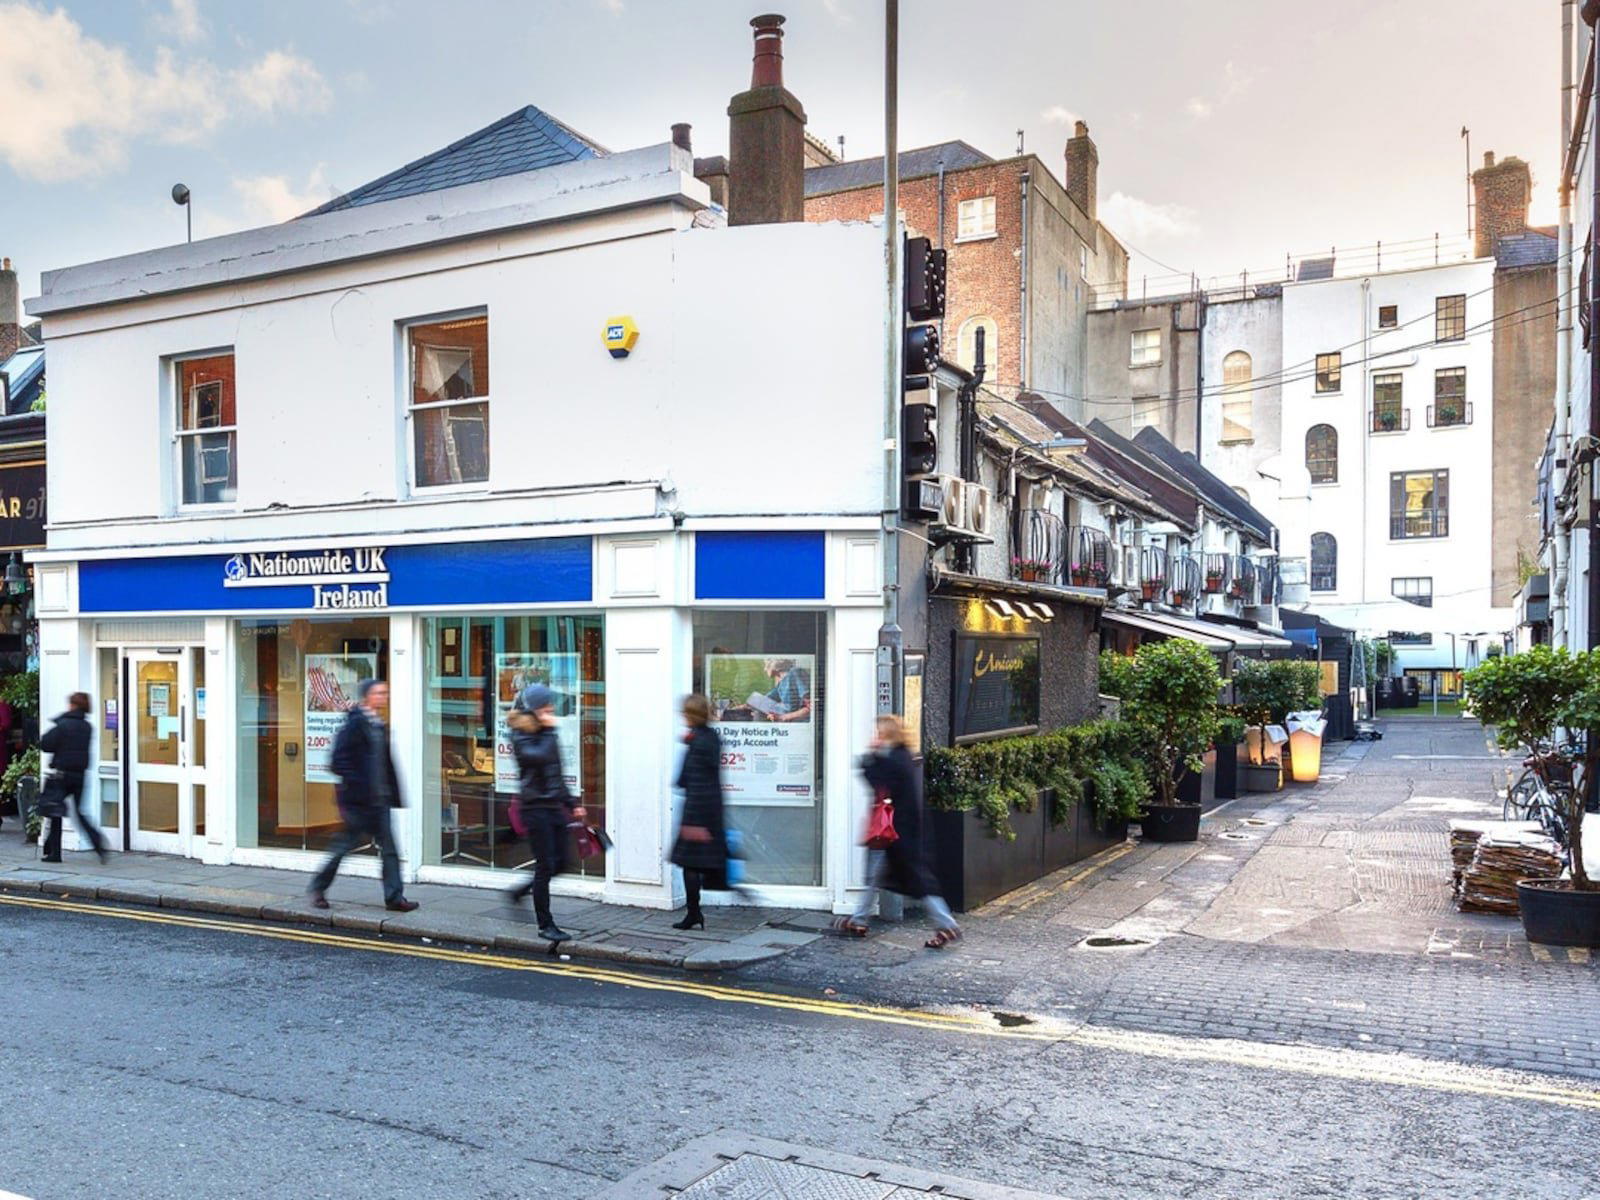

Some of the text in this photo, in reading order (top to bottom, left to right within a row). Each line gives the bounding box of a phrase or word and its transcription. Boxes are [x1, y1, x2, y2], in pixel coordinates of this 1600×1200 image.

[250, 547, 387, 576] Nationwide UK
[312, 583, 388, 609] Ireland
[723, 727, 740, 739] Day
[741, 727, 769, 737] Notice
[771, 727, 789, 737] Plus
[307, 736, 332, 748] 2.00%
[744, 738, 779, 747] Account
